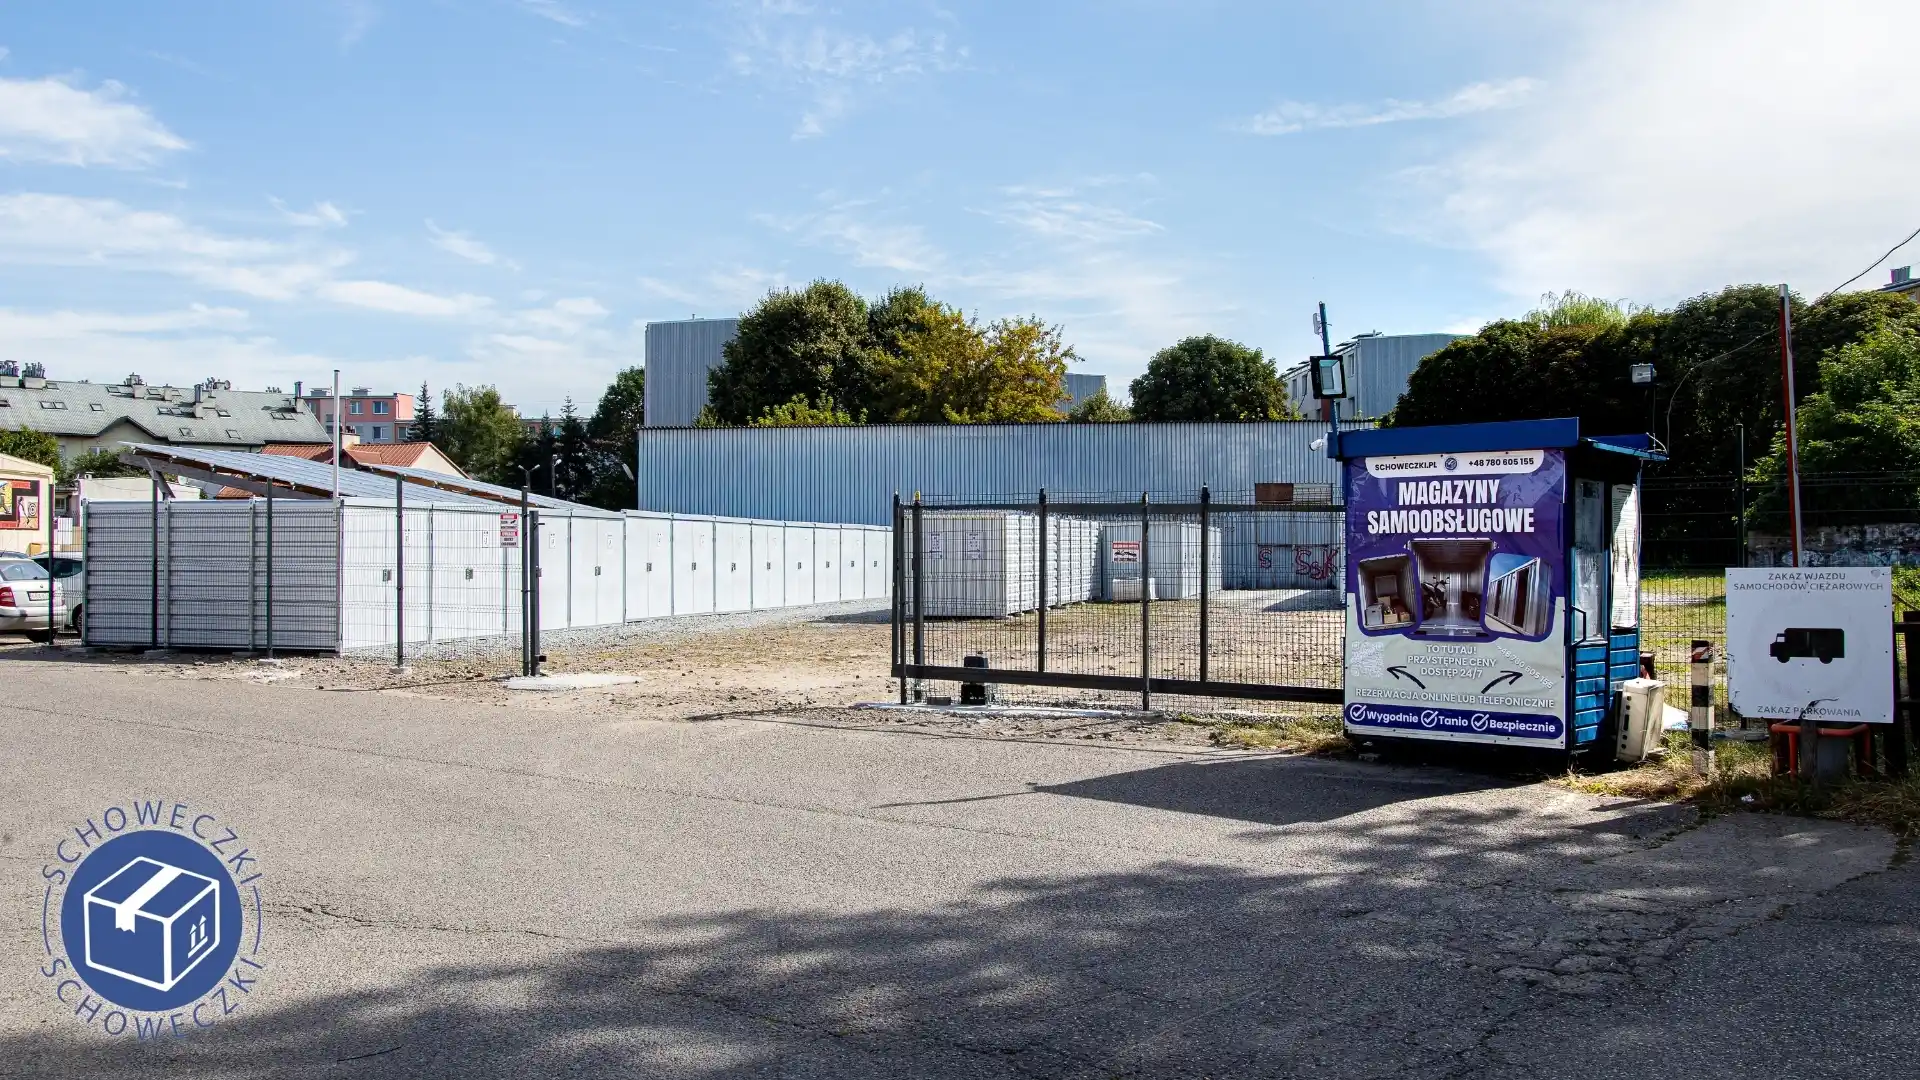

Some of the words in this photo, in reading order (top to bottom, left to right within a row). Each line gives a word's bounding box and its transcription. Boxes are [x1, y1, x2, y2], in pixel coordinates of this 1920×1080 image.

[1375, 461, 1437, 471] SCHOWECZKI.PL
[1468, 459, 1485, 467] +48
[1486, 458, 1501, 467] 780
[1502, 458, 1519, 466] 605
[1520, 457, 1534, 466] 155
[1398, 479, 1500, 506] MAGAZYNY
[1367, 508, 1535, 534] SAMOOBSŁUGOWE
[1768, 573, 1801, 581] ZAKAZ
[1804, 572, 1846, 581] WJAZDU
[1733, 581, 1807, 591] SAMOCHODÓW
[1809, 581, 1883, 592] CIĘŻAROWYCH
[1426, 644, 1440, 654] TO
[1441, 645, 1477, 655] TUTAJ!
[1407, 656, 1468, 667] PRZYSTĘPNE
[1469, 658, 1497, 668] CENY
[1420, 667, 1458, 678] DOSTĘP
[1460, 668, 1483, 679] 24/7
[1524, 666, 1540, 679] 605
[1540, 675, 1554, 689] 155
[1355, 688, 1419, 701] REZERWACJA
[1421, 691, 1456, 703] ONLINE
[1457, 694, 1475, 704] LUB
[1477, 695, 1555, 708] TELEFONICZNIE
[1757, 705, 1791, 714] ZAKAZ
[1793, 706, 1861, 717] PARKOWANIA
[1366, 710, 1419, 724] Wygodnie
[1438, 715, 1469, 727] Tanio
[1489, 719, 1556, 733] Bezpiecznie
